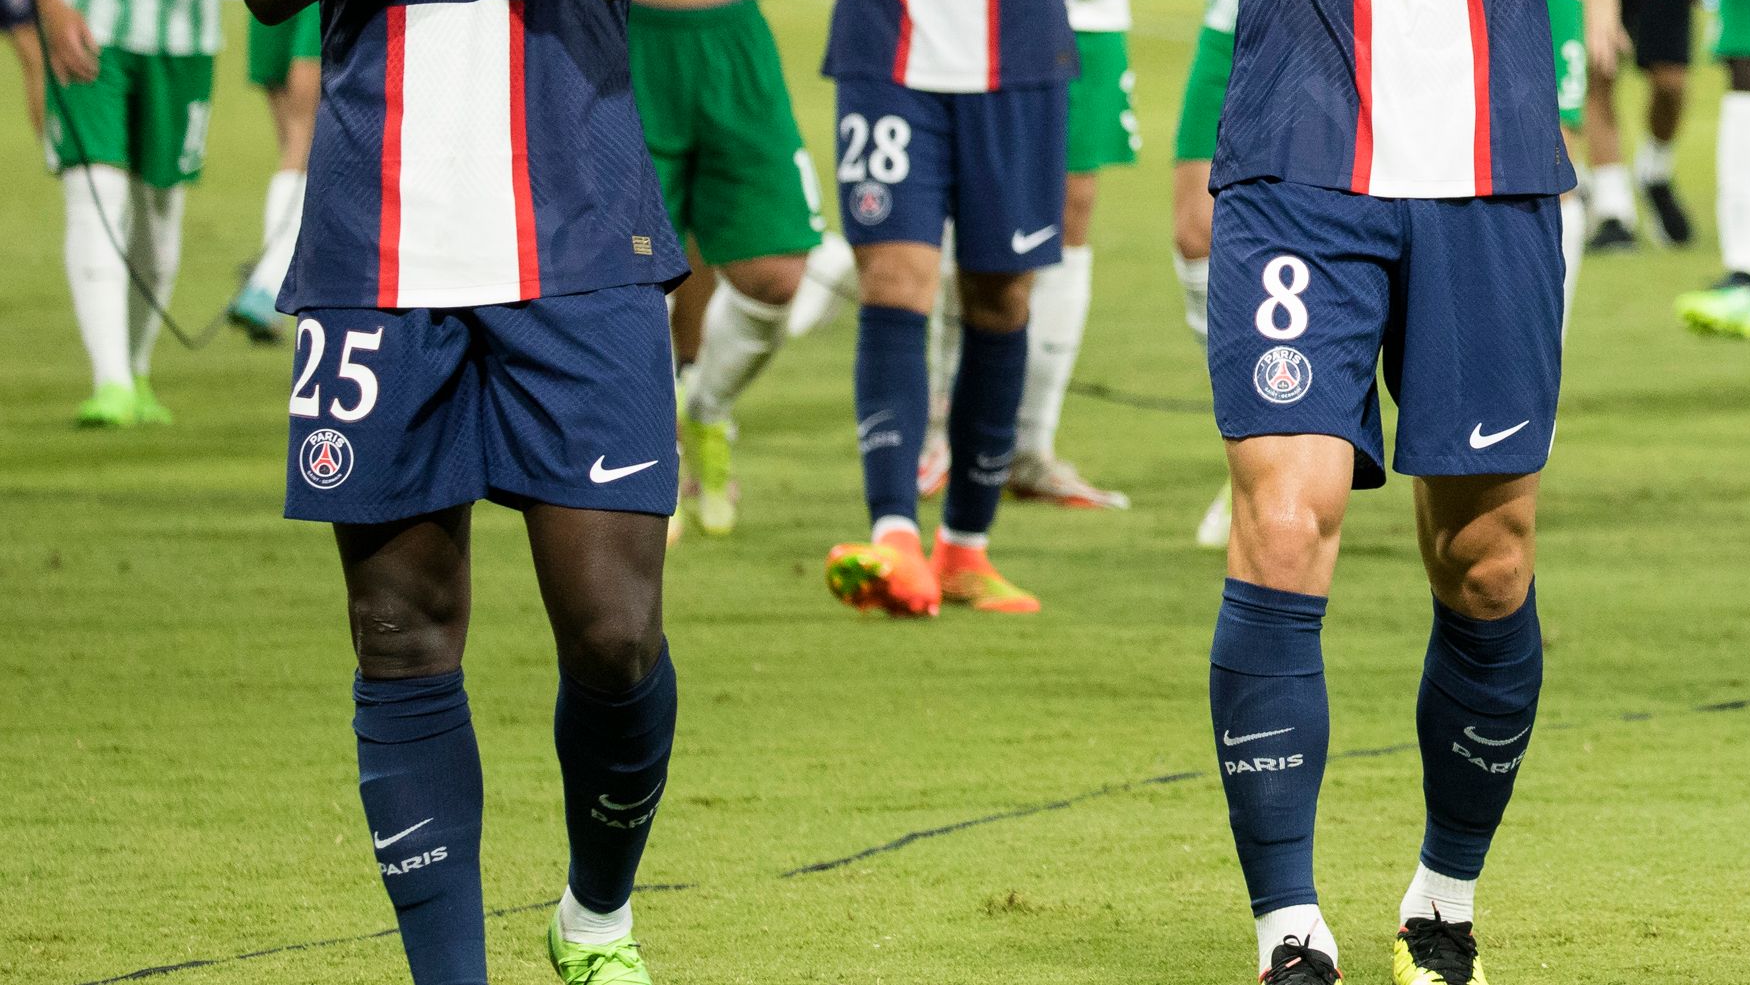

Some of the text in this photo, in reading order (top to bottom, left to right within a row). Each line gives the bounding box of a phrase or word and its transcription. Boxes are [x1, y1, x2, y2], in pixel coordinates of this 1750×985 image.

[837, 112, 912, 185] 28
[1255, 255, 1311, 341] 8
[289, 318, 384, 422] 25
[1264, 350, 1302, 365] PARIS
[309, 432, 345, 448] PARIS
[1224, 754, 1304, 776] PARIS
